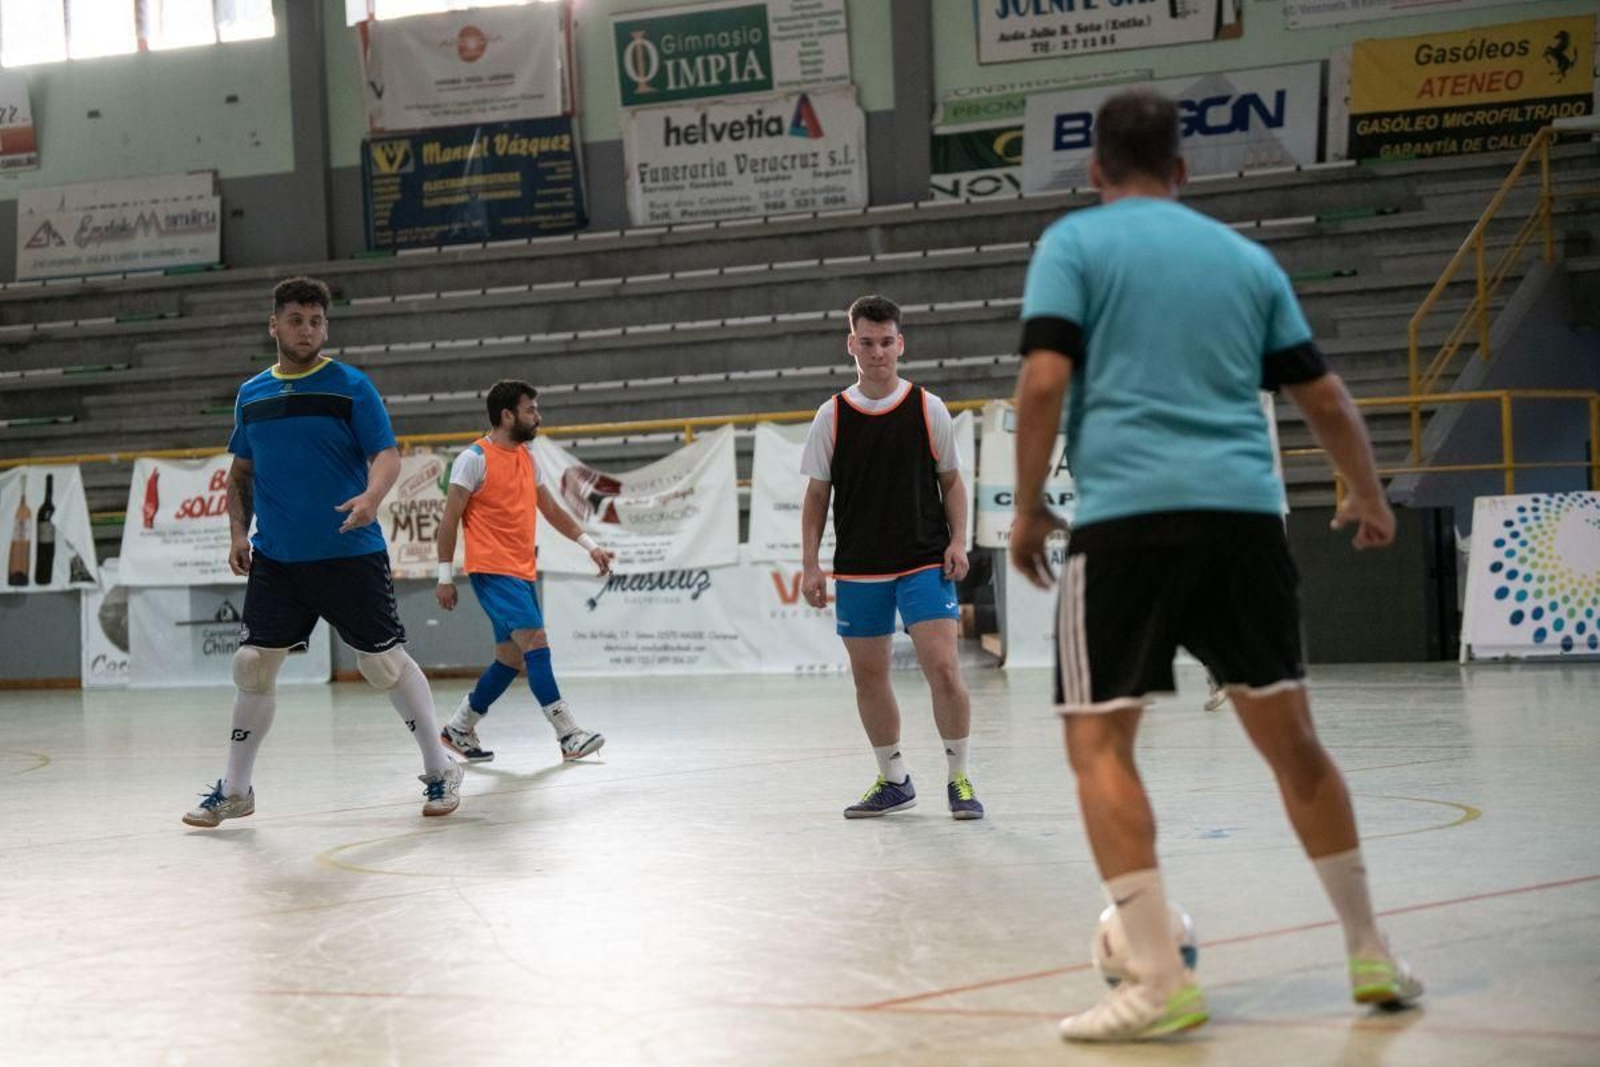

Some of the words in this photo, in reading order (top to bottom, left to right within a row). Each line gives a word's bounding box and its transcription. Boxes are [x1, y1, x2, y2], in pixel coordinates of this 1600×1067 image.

[660, 26, 762, 54] Gimnasio
[1415, 39, 1530, 66] Gasóleos
[1416, 69, 1524, 100] ATENEO
[664, 109, 783, 147] helvetia
[1356, 113, 1438, 136] GASÓLEO
[1442, 101, 1586, 129] MICROFILTRADO
[422, 137, 489, 166] Manuel
[493, 133, 571, 158] Vázquez
[1379, 138, 1458, 159] GARANTÍA
[1462, 136, 1482, 151] DE
[637, 157, 727, 184] Funeraria
[734, 151, 820, 175] Veracruz
